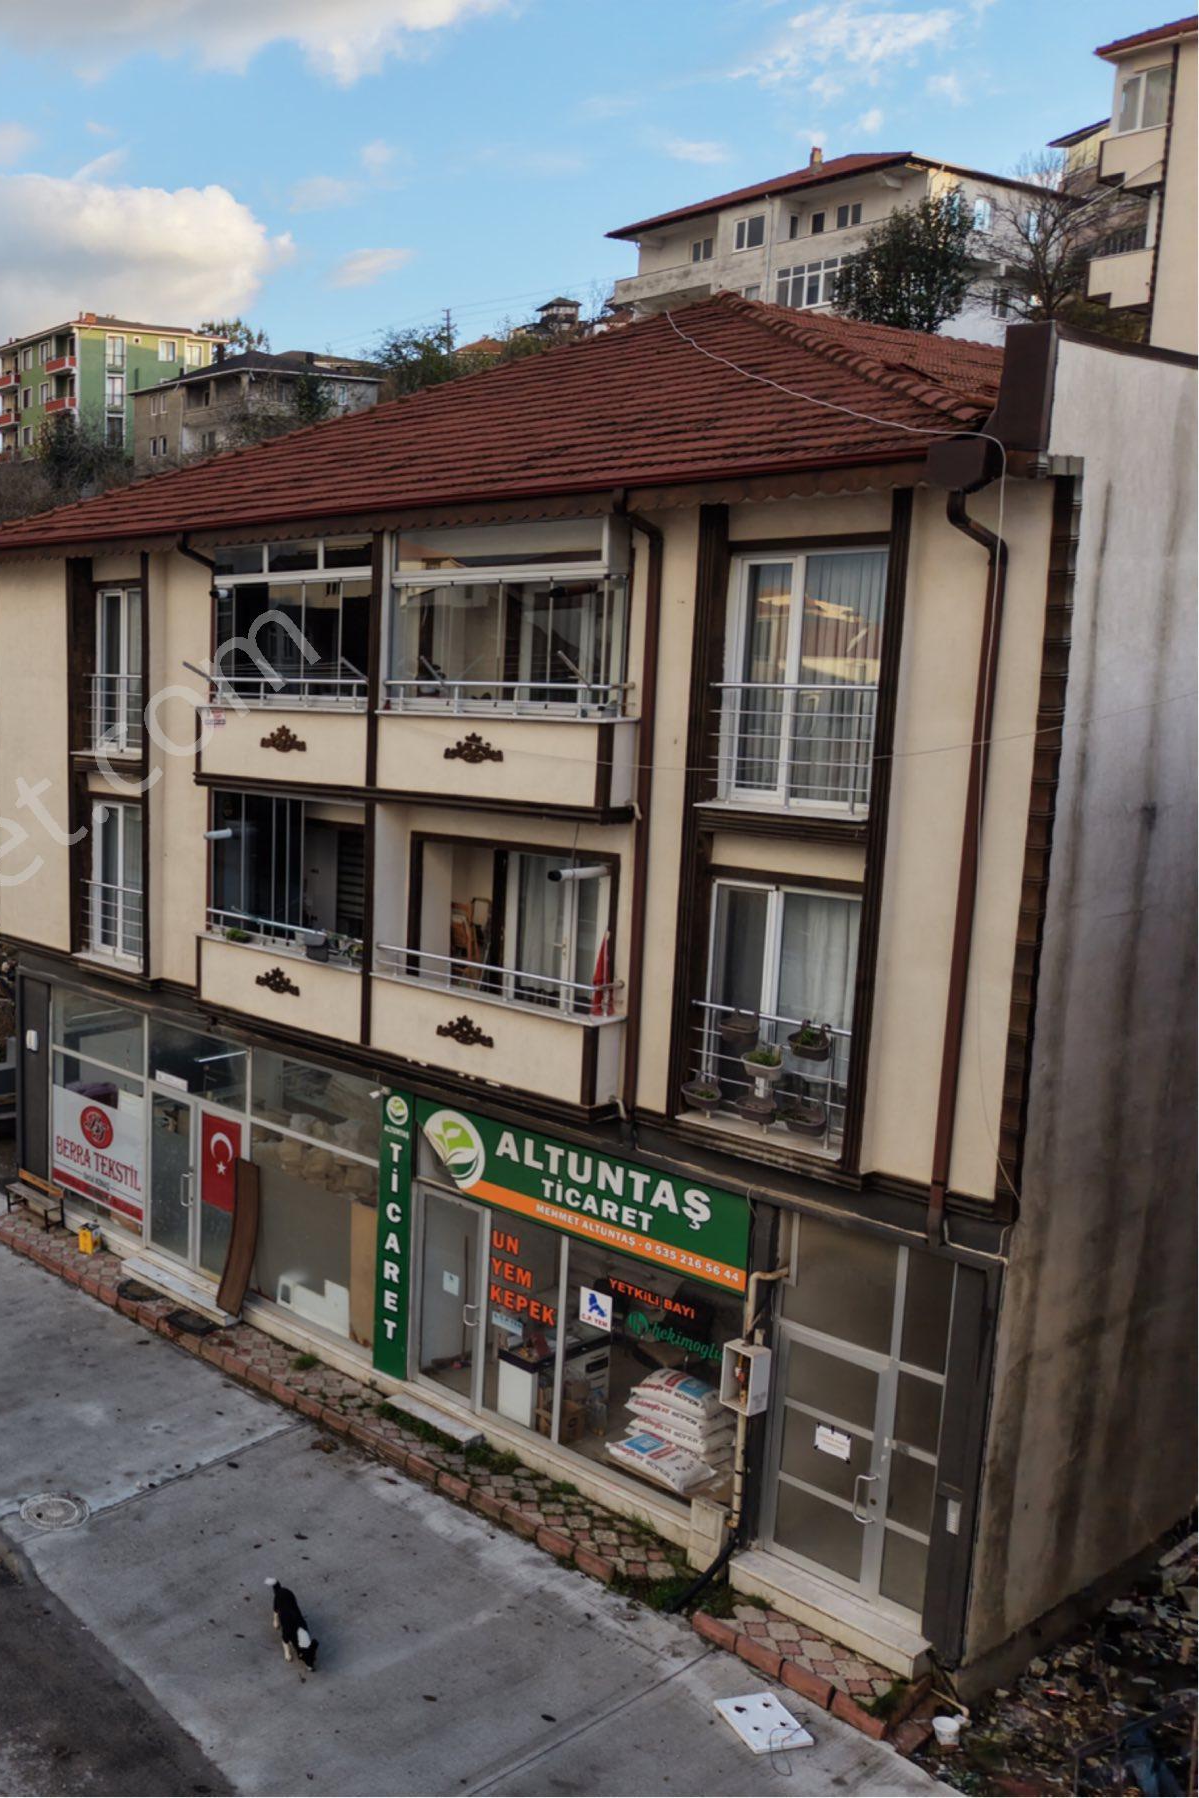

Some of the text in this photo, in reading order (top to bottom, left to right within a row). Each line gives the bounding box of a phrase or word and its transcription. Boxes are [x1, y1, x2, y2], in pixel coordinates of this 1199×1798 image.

[56, 1136, 91, 1168] BERRA
[93, 1152, 141, 1191] TEKSTİL
[495, 1131, 711, 1230] ALTUNTAŞ
[541, 1178, 653, 1232] TİCARET
[383, 1142, 402, 1340] TİCARET
[492, 1230, 519, 1255] UN
[535, 1203, 579, 1226] MEHMET
[582, 1219, 636, 1247] ALTUNTAŞ
[655, 1245, 677, 1261] 535
[680, 1253, 702, 1270] 216
[705, 1260, 721, 1276] 56
[723, 1269, 739, 1282] 44
[491, 1257, 533, 1289] YEM
[609, 1277, 695, 1319] YETKİLİ BAYİ
[490, 1283, 555, 1326] KEPEK
